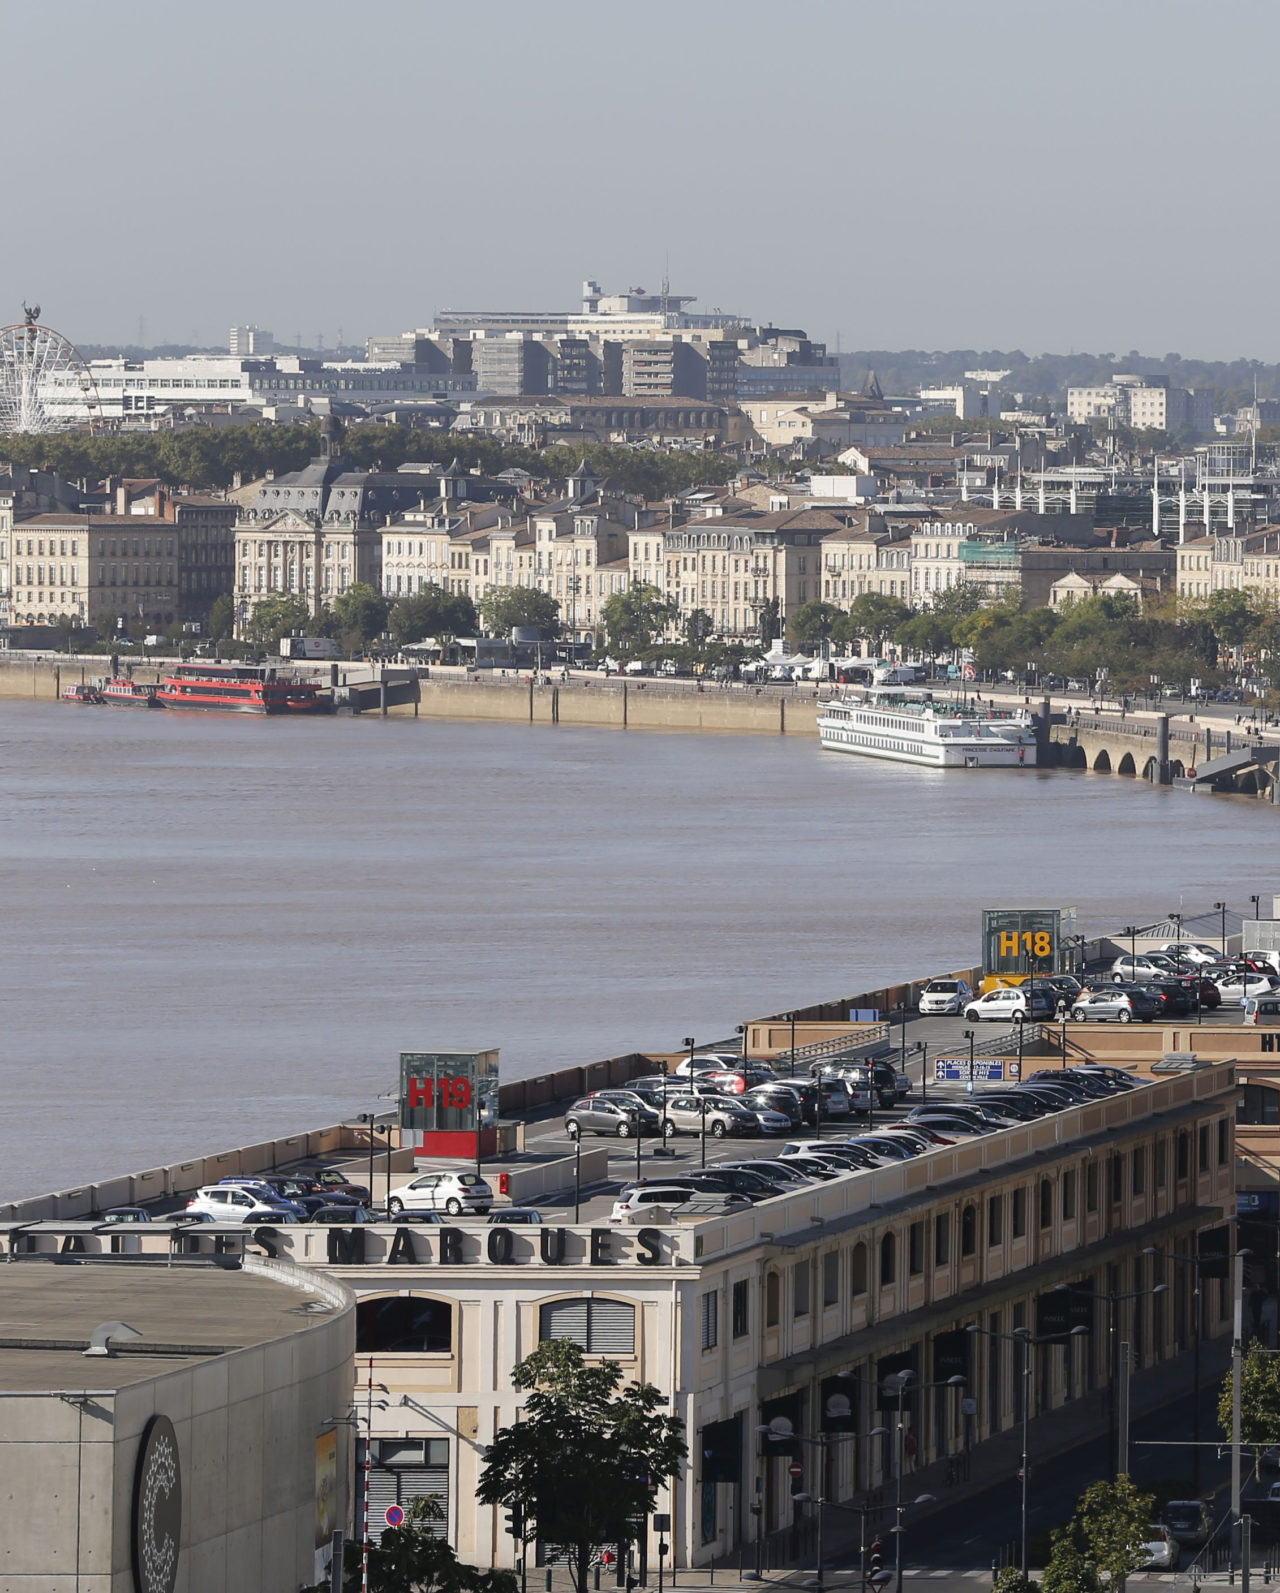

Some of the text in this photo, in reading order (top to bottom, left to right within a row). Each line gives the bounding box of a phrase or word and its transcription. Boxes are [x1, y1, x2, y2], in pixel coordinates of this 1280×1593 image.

[1000, 931, 1051, 957] H18
[409, 1077, 472, 1109] H19
[327, 1227, 661, 1265] MARQUES
